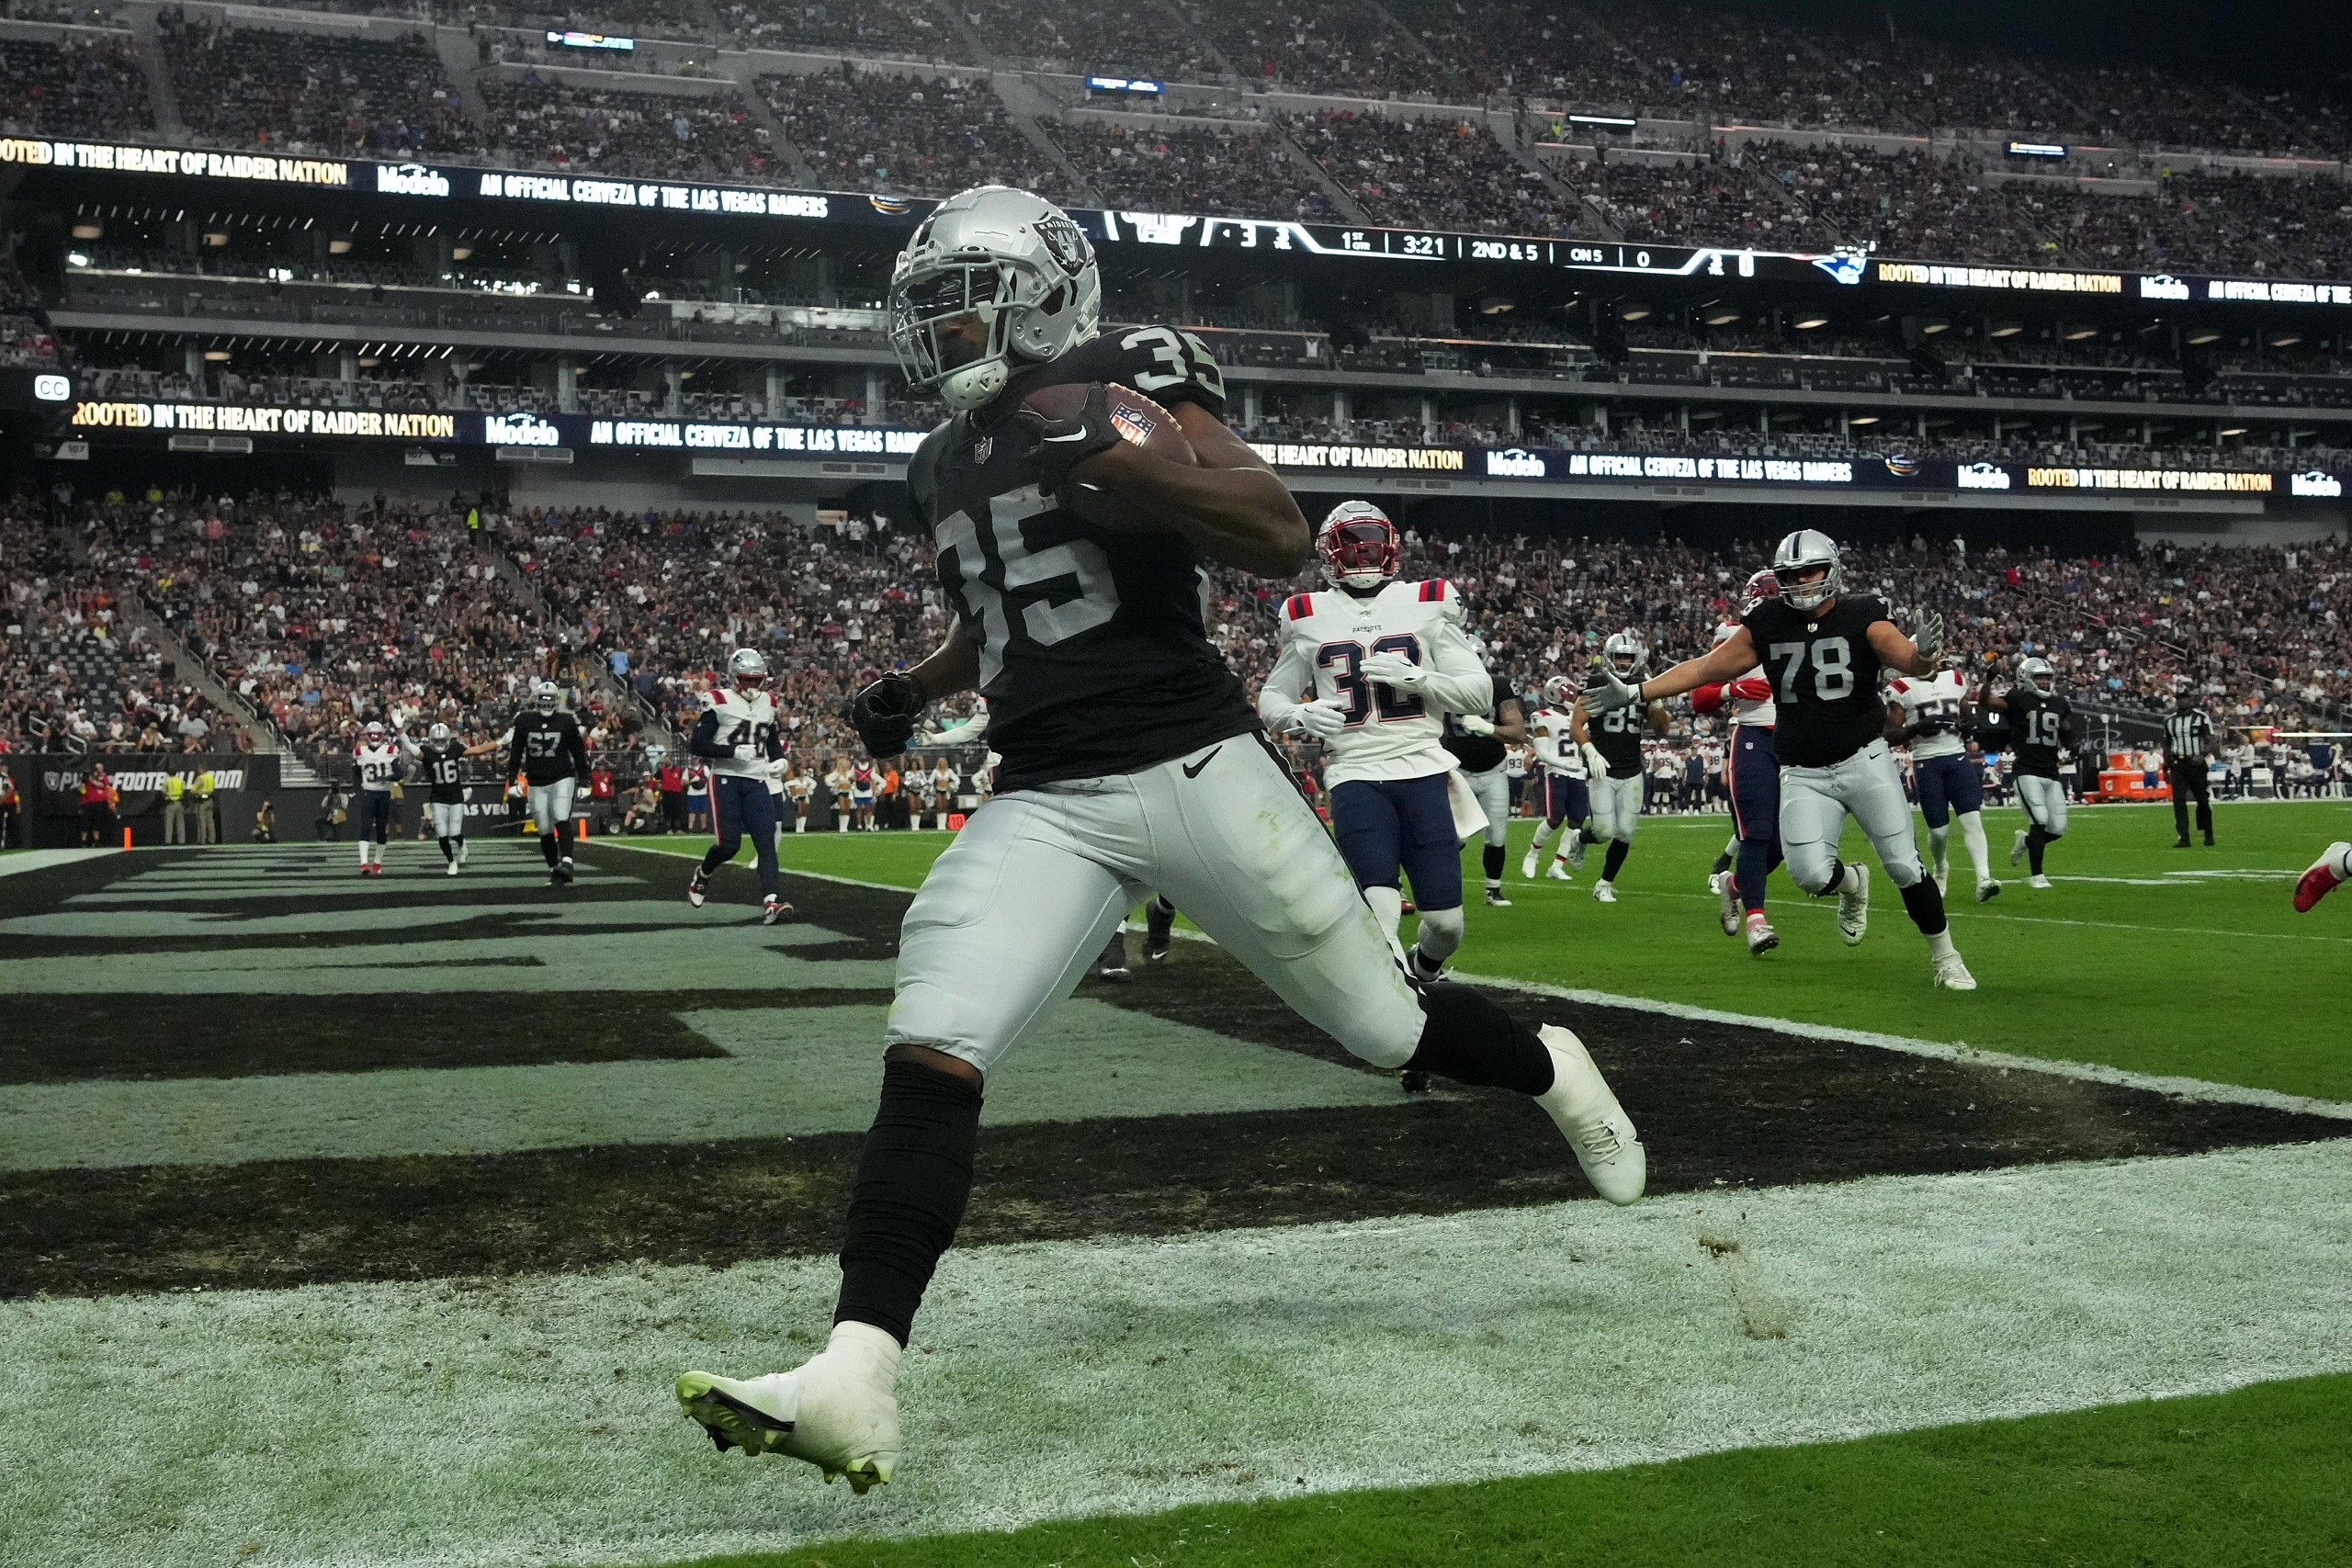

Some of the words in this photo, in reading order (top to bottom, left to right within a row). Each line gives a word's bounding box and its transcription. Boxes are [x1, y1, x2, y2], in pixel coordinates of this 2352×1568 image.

[0, 139, 52, 164] OTED
[54, 142, 74, 166] IN
[75, 144, 115, 169] THE
[116, 147, 180, 173] HEART
[180, 152, 207, 175] OF
[209, 154, 277, 180] RAIDER
[279, 159, 346, 185] NATION
[378, 165, 449, 197] Modelo
[480, 174, 502, 196] AN
[504, 175, 571, 200] OFFICIAL
[572, 180, 637, 205] CERVEZA
[639, 185, 659, 207] OF
[661, 186, 689, 209] THE
[692, 189, 718, 211] LAS
[720, 191, 766, 214] VEGAS
[768, 194, 828, 218] RAIDERS
[1240, 224, 1256, 247] 3
[1341, 231, 1351, 249] 1
[1403, 235, 1443, 255] 3:21
[1472, 242, 1507, 259] 2ND
[1510, 243, 1523, 260] &
[1526, 244, 1538, 261] 5
[1570, 247, 1592, 262] ON
[1593, 249, 1603, 263] 5
[1636, 251, 1650, 267] 0
[1879, 264, 1928, 283] ROOTED
[1929, 266, 1943, 285] IN
[1944, 267, 1968, 286] THE
[1969, 268, 2010, 288] HEART
[2011, 271, 2029, 288] OF
[2030, 272, 2075, 291] RAIDER
[2076, 274, 2121, 293] NATION
[2141, 276, 2189, 300] Modelo
[2224, 281, 2270, 300] OFFICIAL
[2316, 285, 2331, 303] OF
[1120, 326, 1226, 400] 35
[40, 380, 64, 396] CC
[72, 401, 153, 427] ROOTED
[153, 404, 174, 428] IN
[175, 405, 214, 429] THE
[217, 407, 282, 432] HEART
[283, 409, 311, 433] OF
[312, 411, 383, 435] RAIDER
[385, 413, 454, 437] NATION
[486, 416, 560, 446] Modelo
[591, 422, 613, 445] AN
[616, 422, 683, 446] OFFICIAL
[685, 424, 750, 448] CERVEZA
[752, 426, 774, 449] OF
[775, 427, 804, 450] THE
[808, 428, 835, 451] LAS
[837, 430, 883, 453] VEGAS
[1278, 445, 1329, 466] HEART
[1329, 446, 1351, 467] OF
[1351, 447, 1408, 468] RAIDER
[1408, 449, 1463, 469] NATION
[1487, 451, 1545, 477] Modelo
[1569, 455, 1588, 475] AN
[1589, 456, 1643, 476] OFFICIAL
[1645, 457, 1697, 477] CERVEZA
[1699, 458, 1714, 478] OF
[1715, 459, 1739, 479] THE
[1741, 459, 1763, 479] LAS
[1764, 460, 1801, 481] VEGAS
[1803, 461, 1852, 482] RAIDERS
[1958, 466, 2009, 490] Modelo
[2028, 468, 2078, 487] ROOTED
[2079, 469, 2093, 487] IN
[2094, 469, 2119, 488] THE
[2120, 470, 2161, 489] HEART
[2162, 471, 2179, 490] OF
[2180, 471, 2226, 491] RAIDER
[2227, 473, 2272, 491] NATION
[2291, 474, 2341, 496] Modelo
[1352, 625, 1382, 634] PATRIOTS
[1316, 632, 1426, 728] 32
[1770, 637, 1854, 704] 78
[2026, 710, 2060, 747] 19
[432, 760, 458, 784] 16
